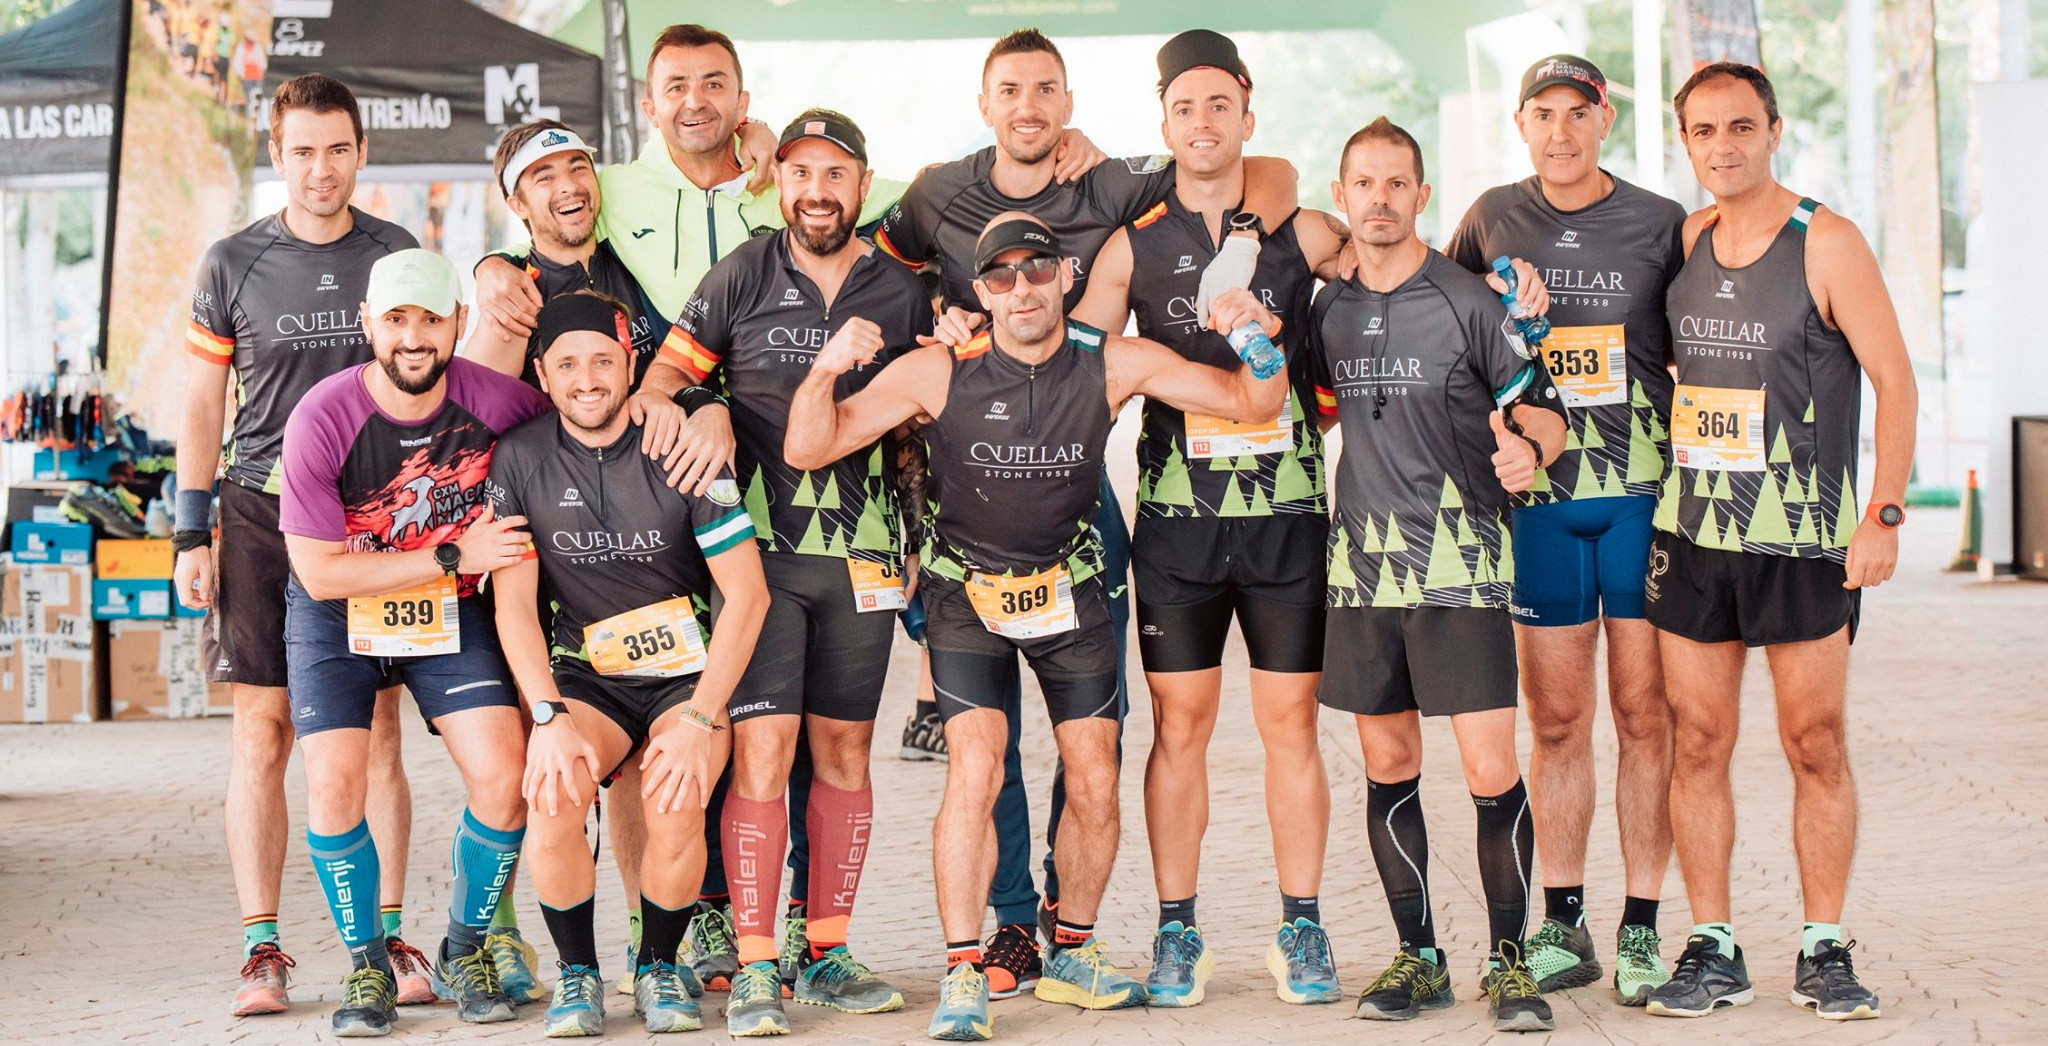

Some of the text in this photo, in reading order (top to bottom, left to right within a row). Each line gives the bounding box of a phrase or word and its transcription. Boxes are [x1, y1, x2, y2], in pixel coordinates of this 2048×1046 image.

[14, 105, 62, 139] LAS
[64, 104, 114, 138] CAR
[1536, 268, 1626, 290] UELLAR
[1575, 297, 1609, 307] 1958
[276, 310, 364, 334] CUELLA
[1680, 315, 1767, 344] CUELLAR
[292, 338, 337, 351] STONE
[1687, 347, 1752, 361] STONE 1958
[1335, 357, 1423, 381] CUELLAR
[1548, 348, 1599, 377] 353
[1341, 386, 1408, 399] STONE 1958
[1697, 410, 1740, 439] 364
[970, 442, 1085, 464] CUELLAR
[1195, 443, 1209, 452] 112
[1677, 451, 1687, 461] 112
[984, 469, 1070, 479] STONE 1958
[433, 481, 460, 500] CXM
[552, 529, 665, 551] CUELLAR
[570, 552, 617, 565] STONE
[863, 596, 875, 606] 112
[1000, 584, 1048, 615] 369
[383, 599, 434, 627] 339
[355, 640, 370, 650] 112
[622, 623, 676, 662] 355
